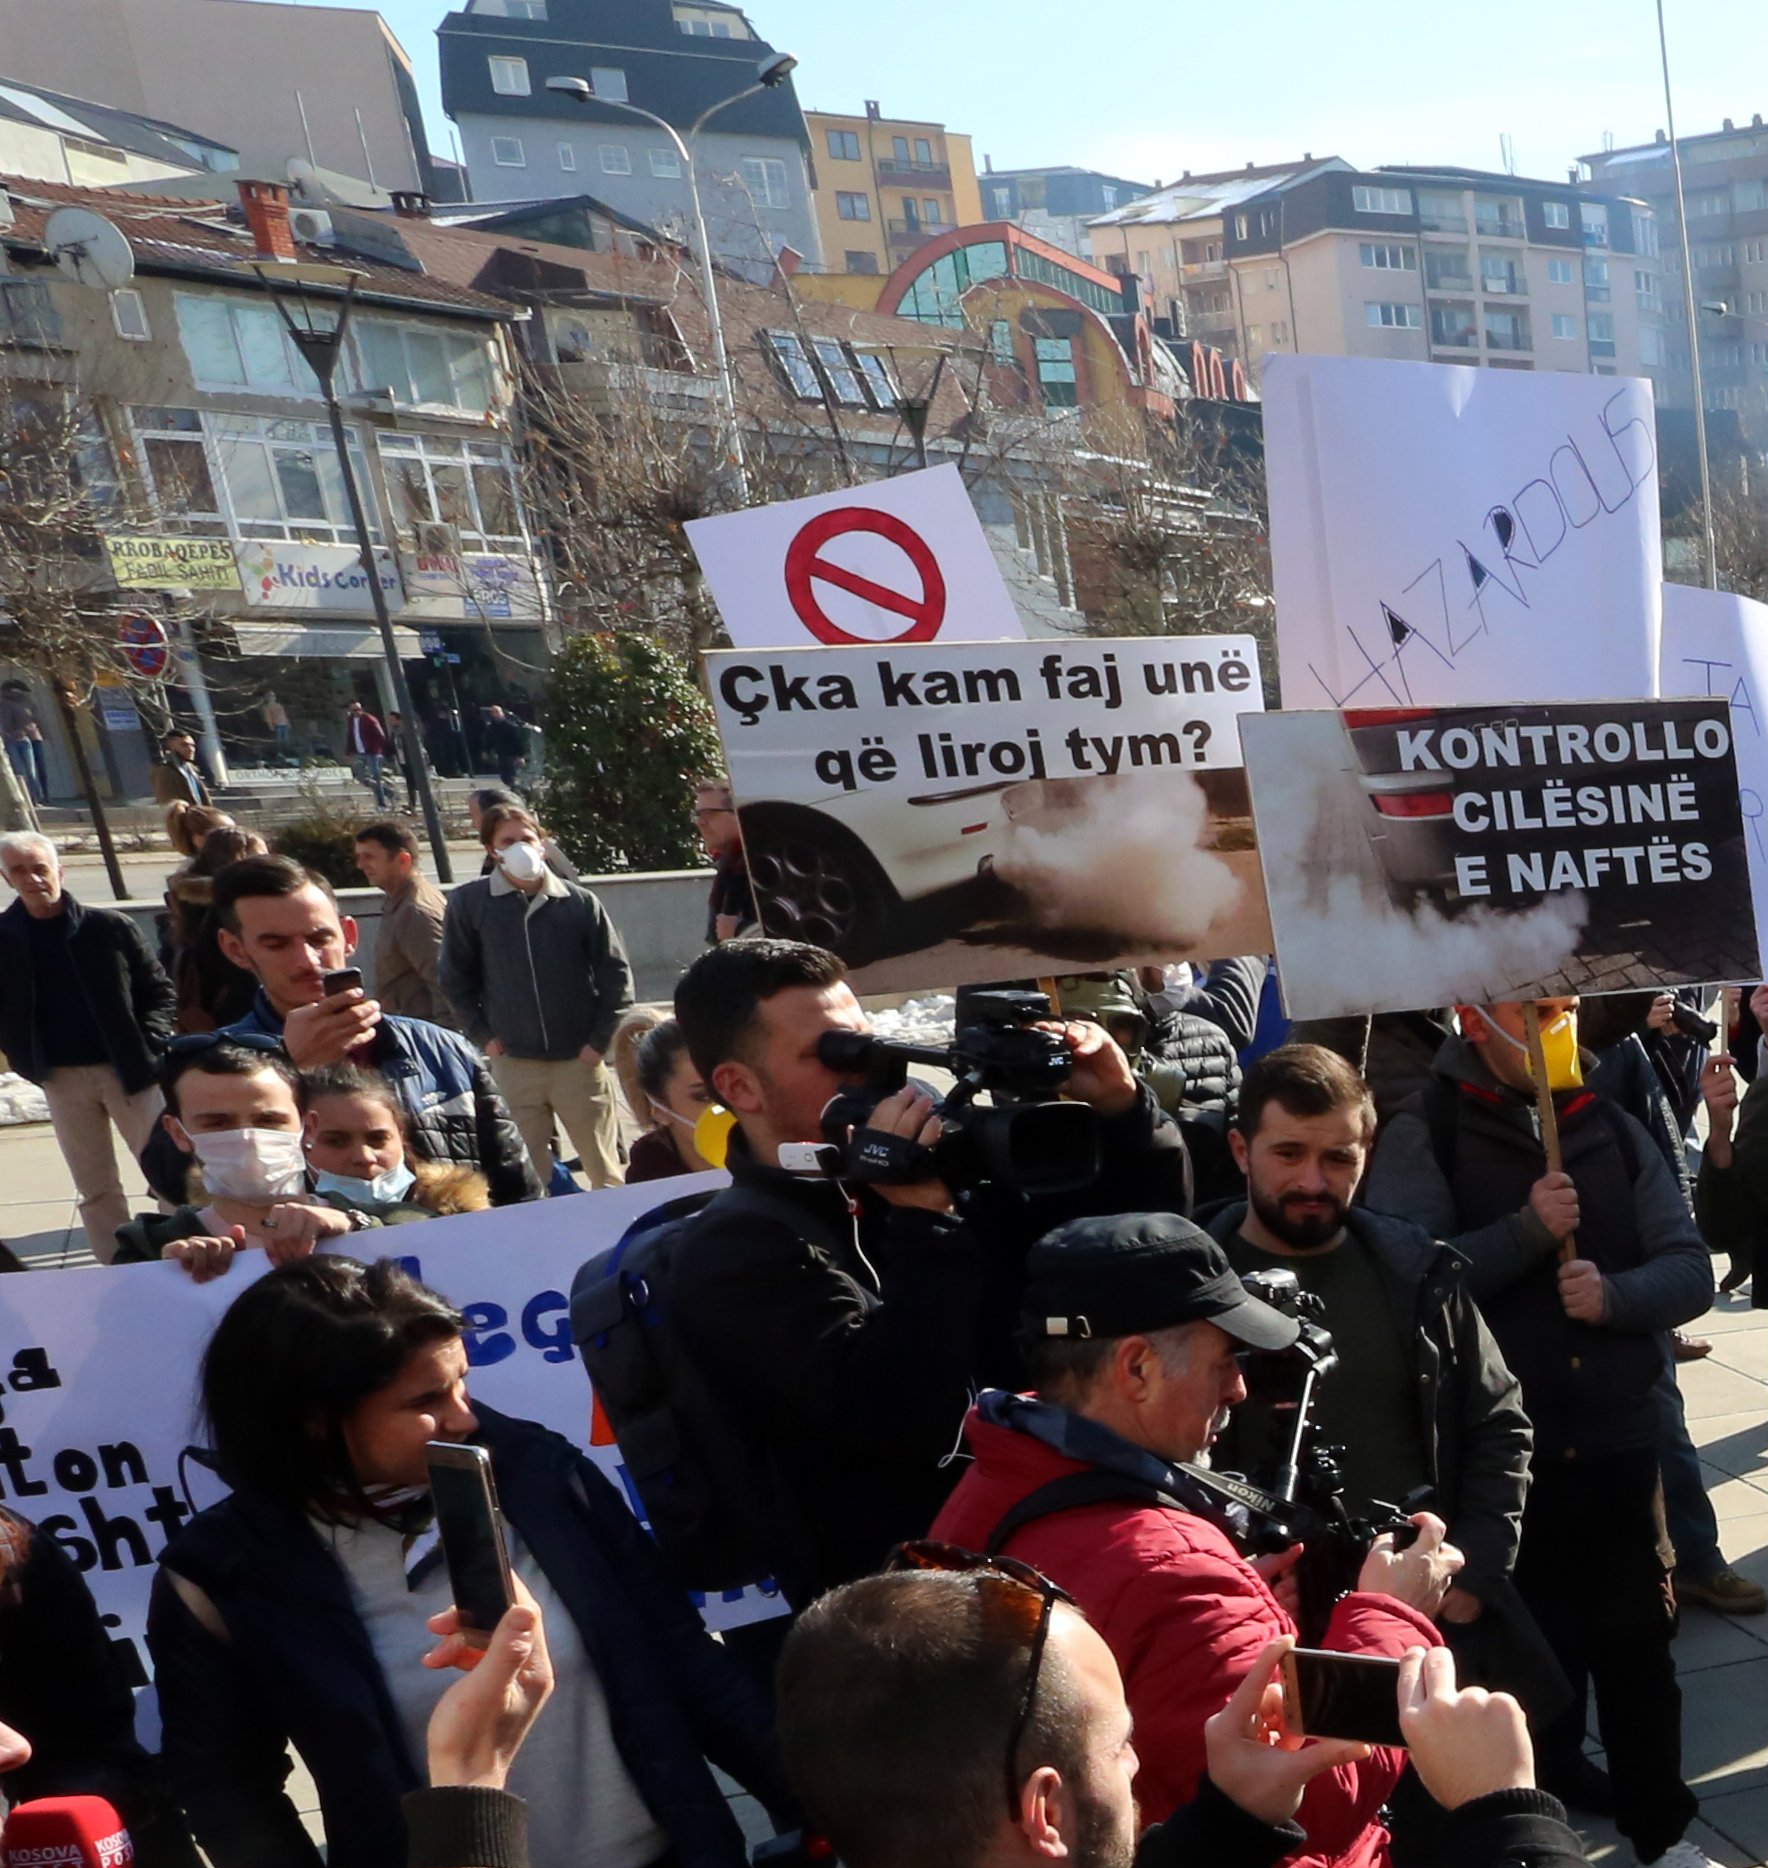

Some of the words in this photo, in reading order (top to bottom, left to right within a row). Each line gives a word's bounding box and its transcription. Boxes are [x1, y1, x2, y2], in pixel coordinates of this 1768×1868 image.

[1307, 387, 1656, 706] HAZARDOUS
[277, 563, 330, 589] Kids
[334, 571, 396, 590] Corer
[718, 664, 859, 727] Çka
[877, 651, 1021, 708] kam
[1040, 653, 1121, 708] faj
[1144, 649, 1252, 695] unë
[814, 736, 898, 790] që
[918, 727, 1047, 781] liroj
[1065, 720, 1213, 776] tym?
[1397, 719, 1731, 772] KONTROLLO
[1451, 774, 1700, 833] CILËSINË
[1454, 854, 1490, 897] E
[1507, 835, 1713, 892] NAFTËS
[863, 1144, 891, 1158] JVC
[1227, 1482, 1276, 1512] Nikon
[9, 1843, 82, 1862] KOSOVA
